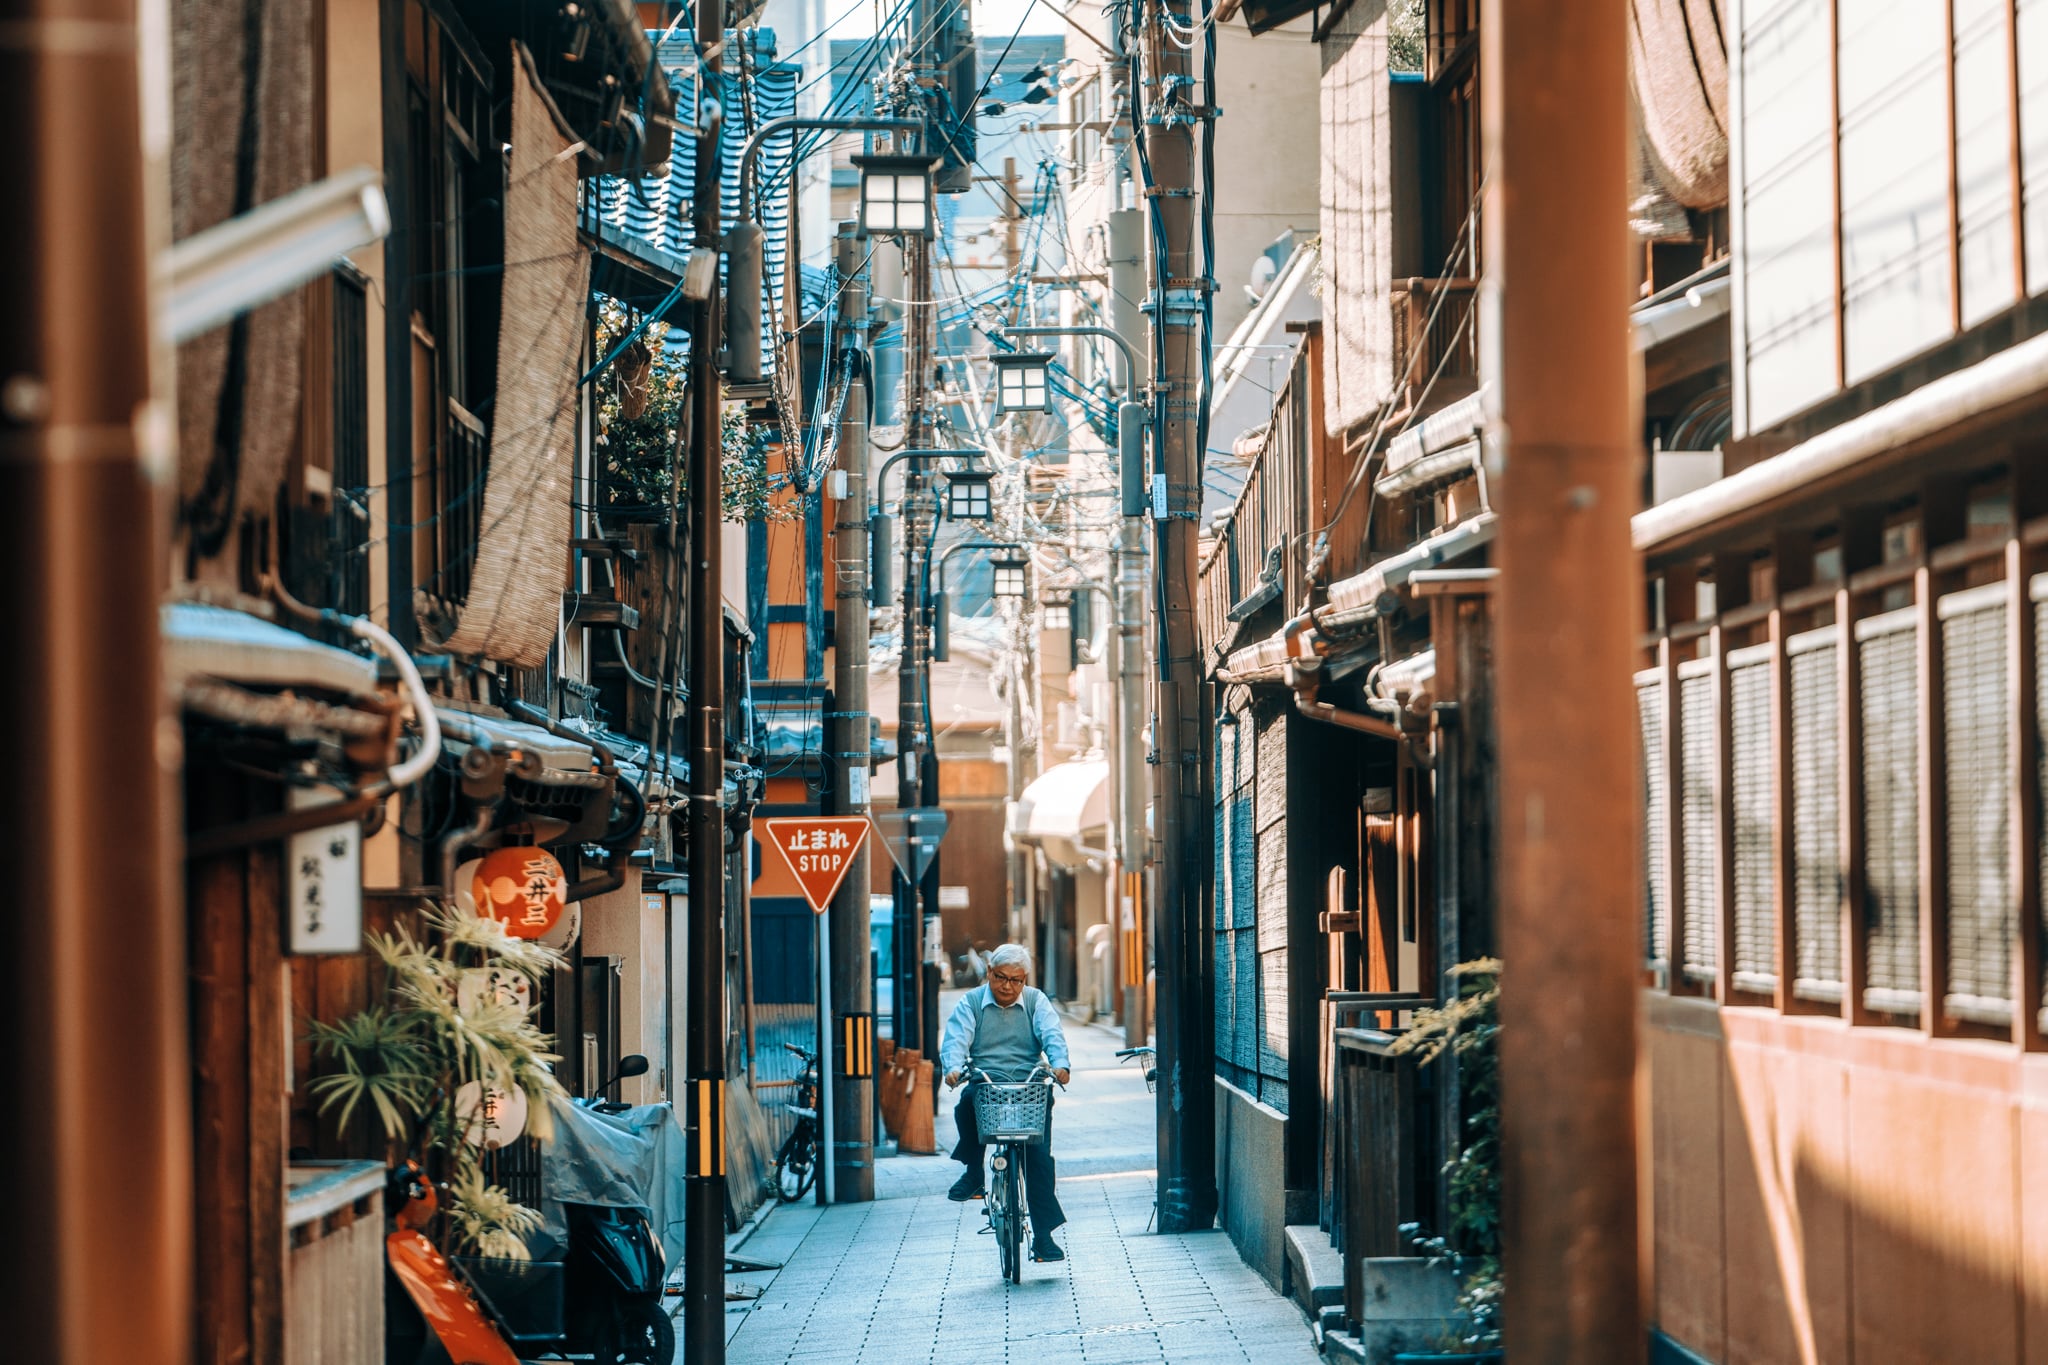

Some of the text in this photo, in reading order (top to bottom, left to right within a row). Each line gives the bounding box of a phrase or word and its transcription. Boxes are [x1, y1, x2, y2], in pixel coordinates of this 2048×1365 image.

[788, 828, 850, 850] 止まれ
[799, 854, 841, 872] STOP
